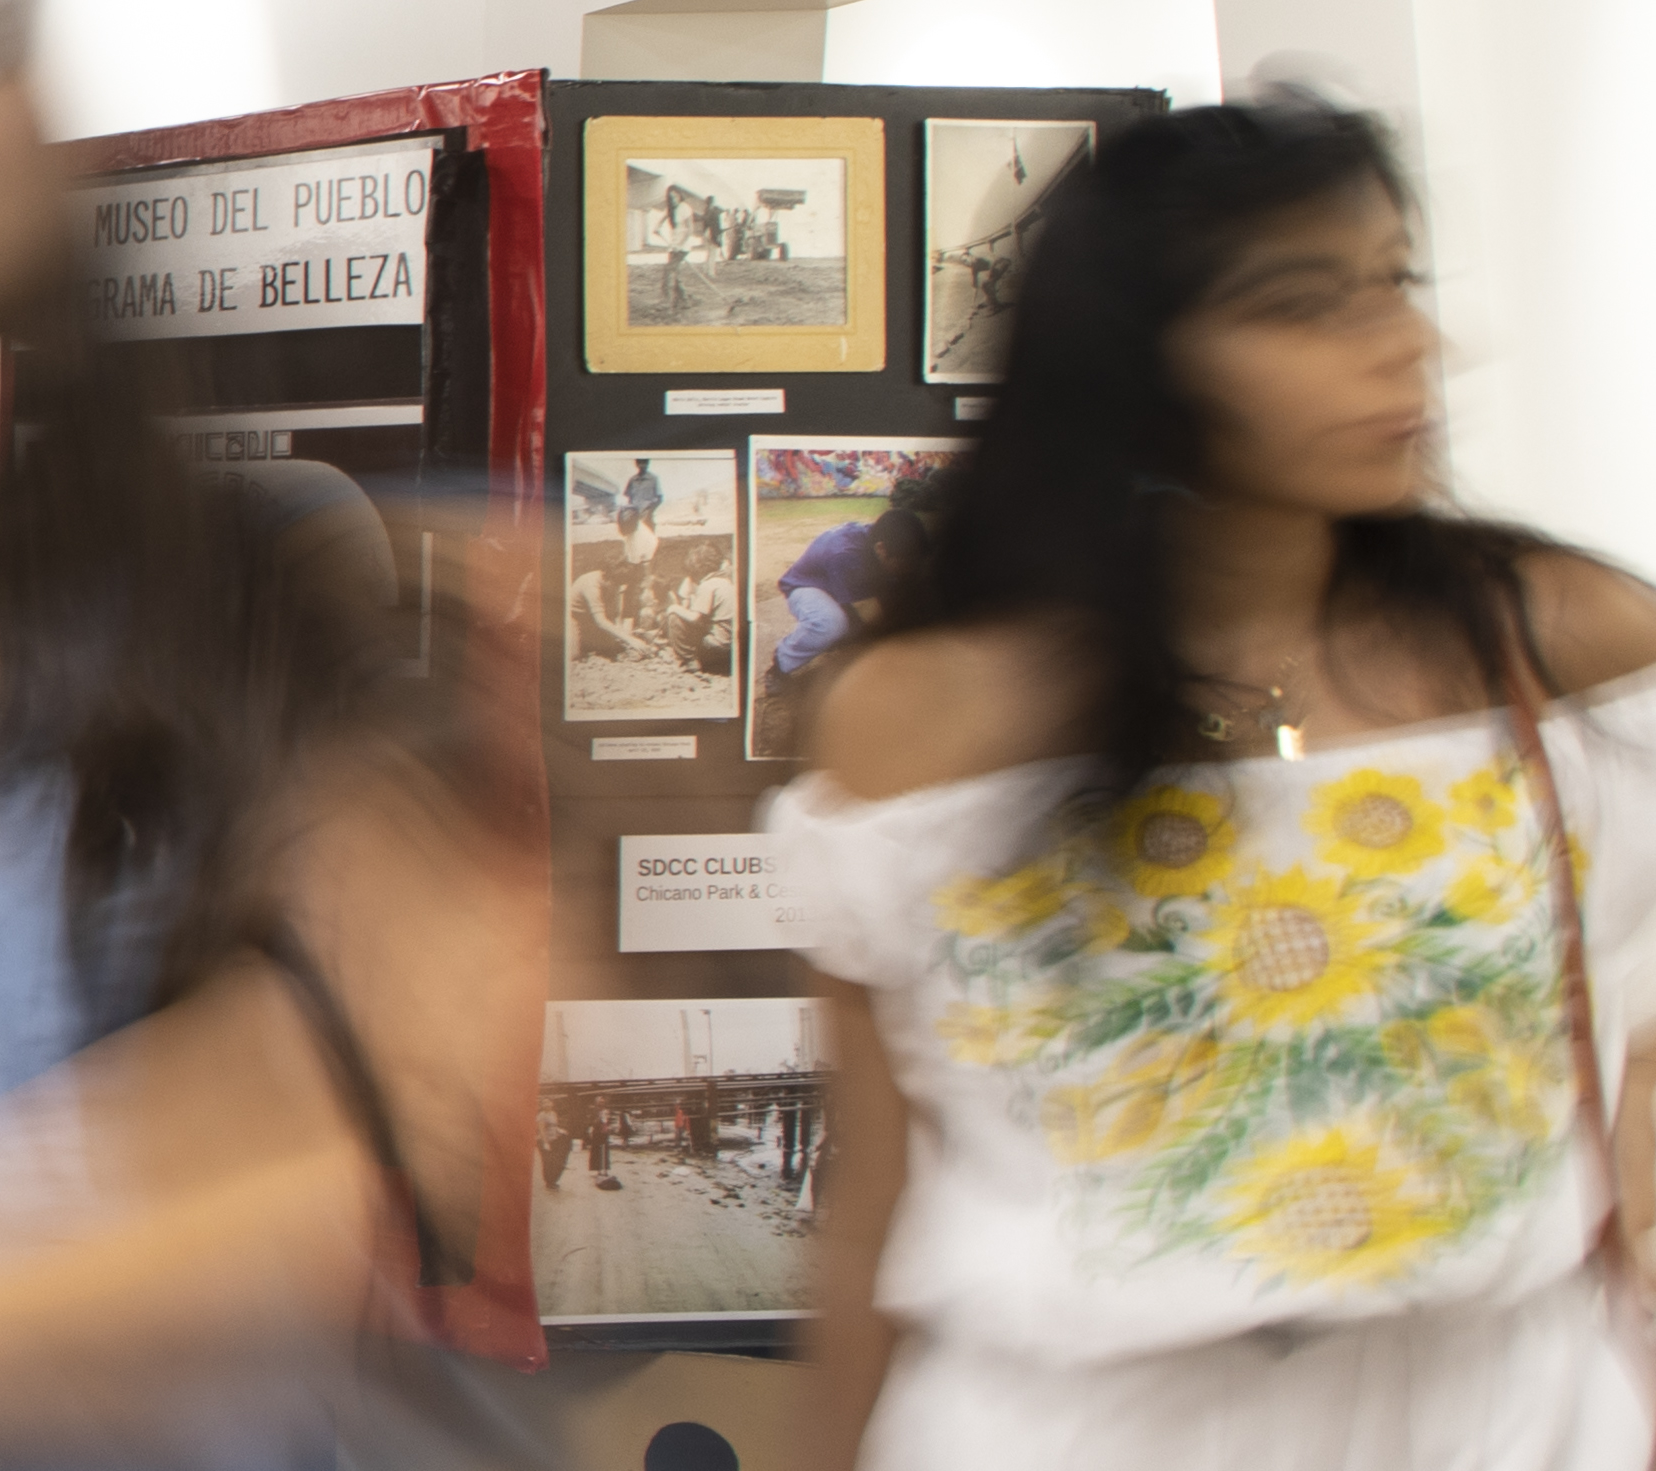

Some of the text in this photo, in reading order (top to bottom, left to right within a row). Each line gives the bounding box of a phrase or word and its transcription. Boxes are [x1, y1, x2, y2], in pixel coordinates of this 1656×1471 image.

[94, 169, 427, 248] MUSEO DEL PUEBLO
[86, 252, 413, 321] GRAMA DE BELLEZA
[638, 857, 777, 876] SDCC CLUBS
[636, 885, 702, 901] Chicano
[707, 884, 744, 900] Park
[748, 885, 761, 899] &
